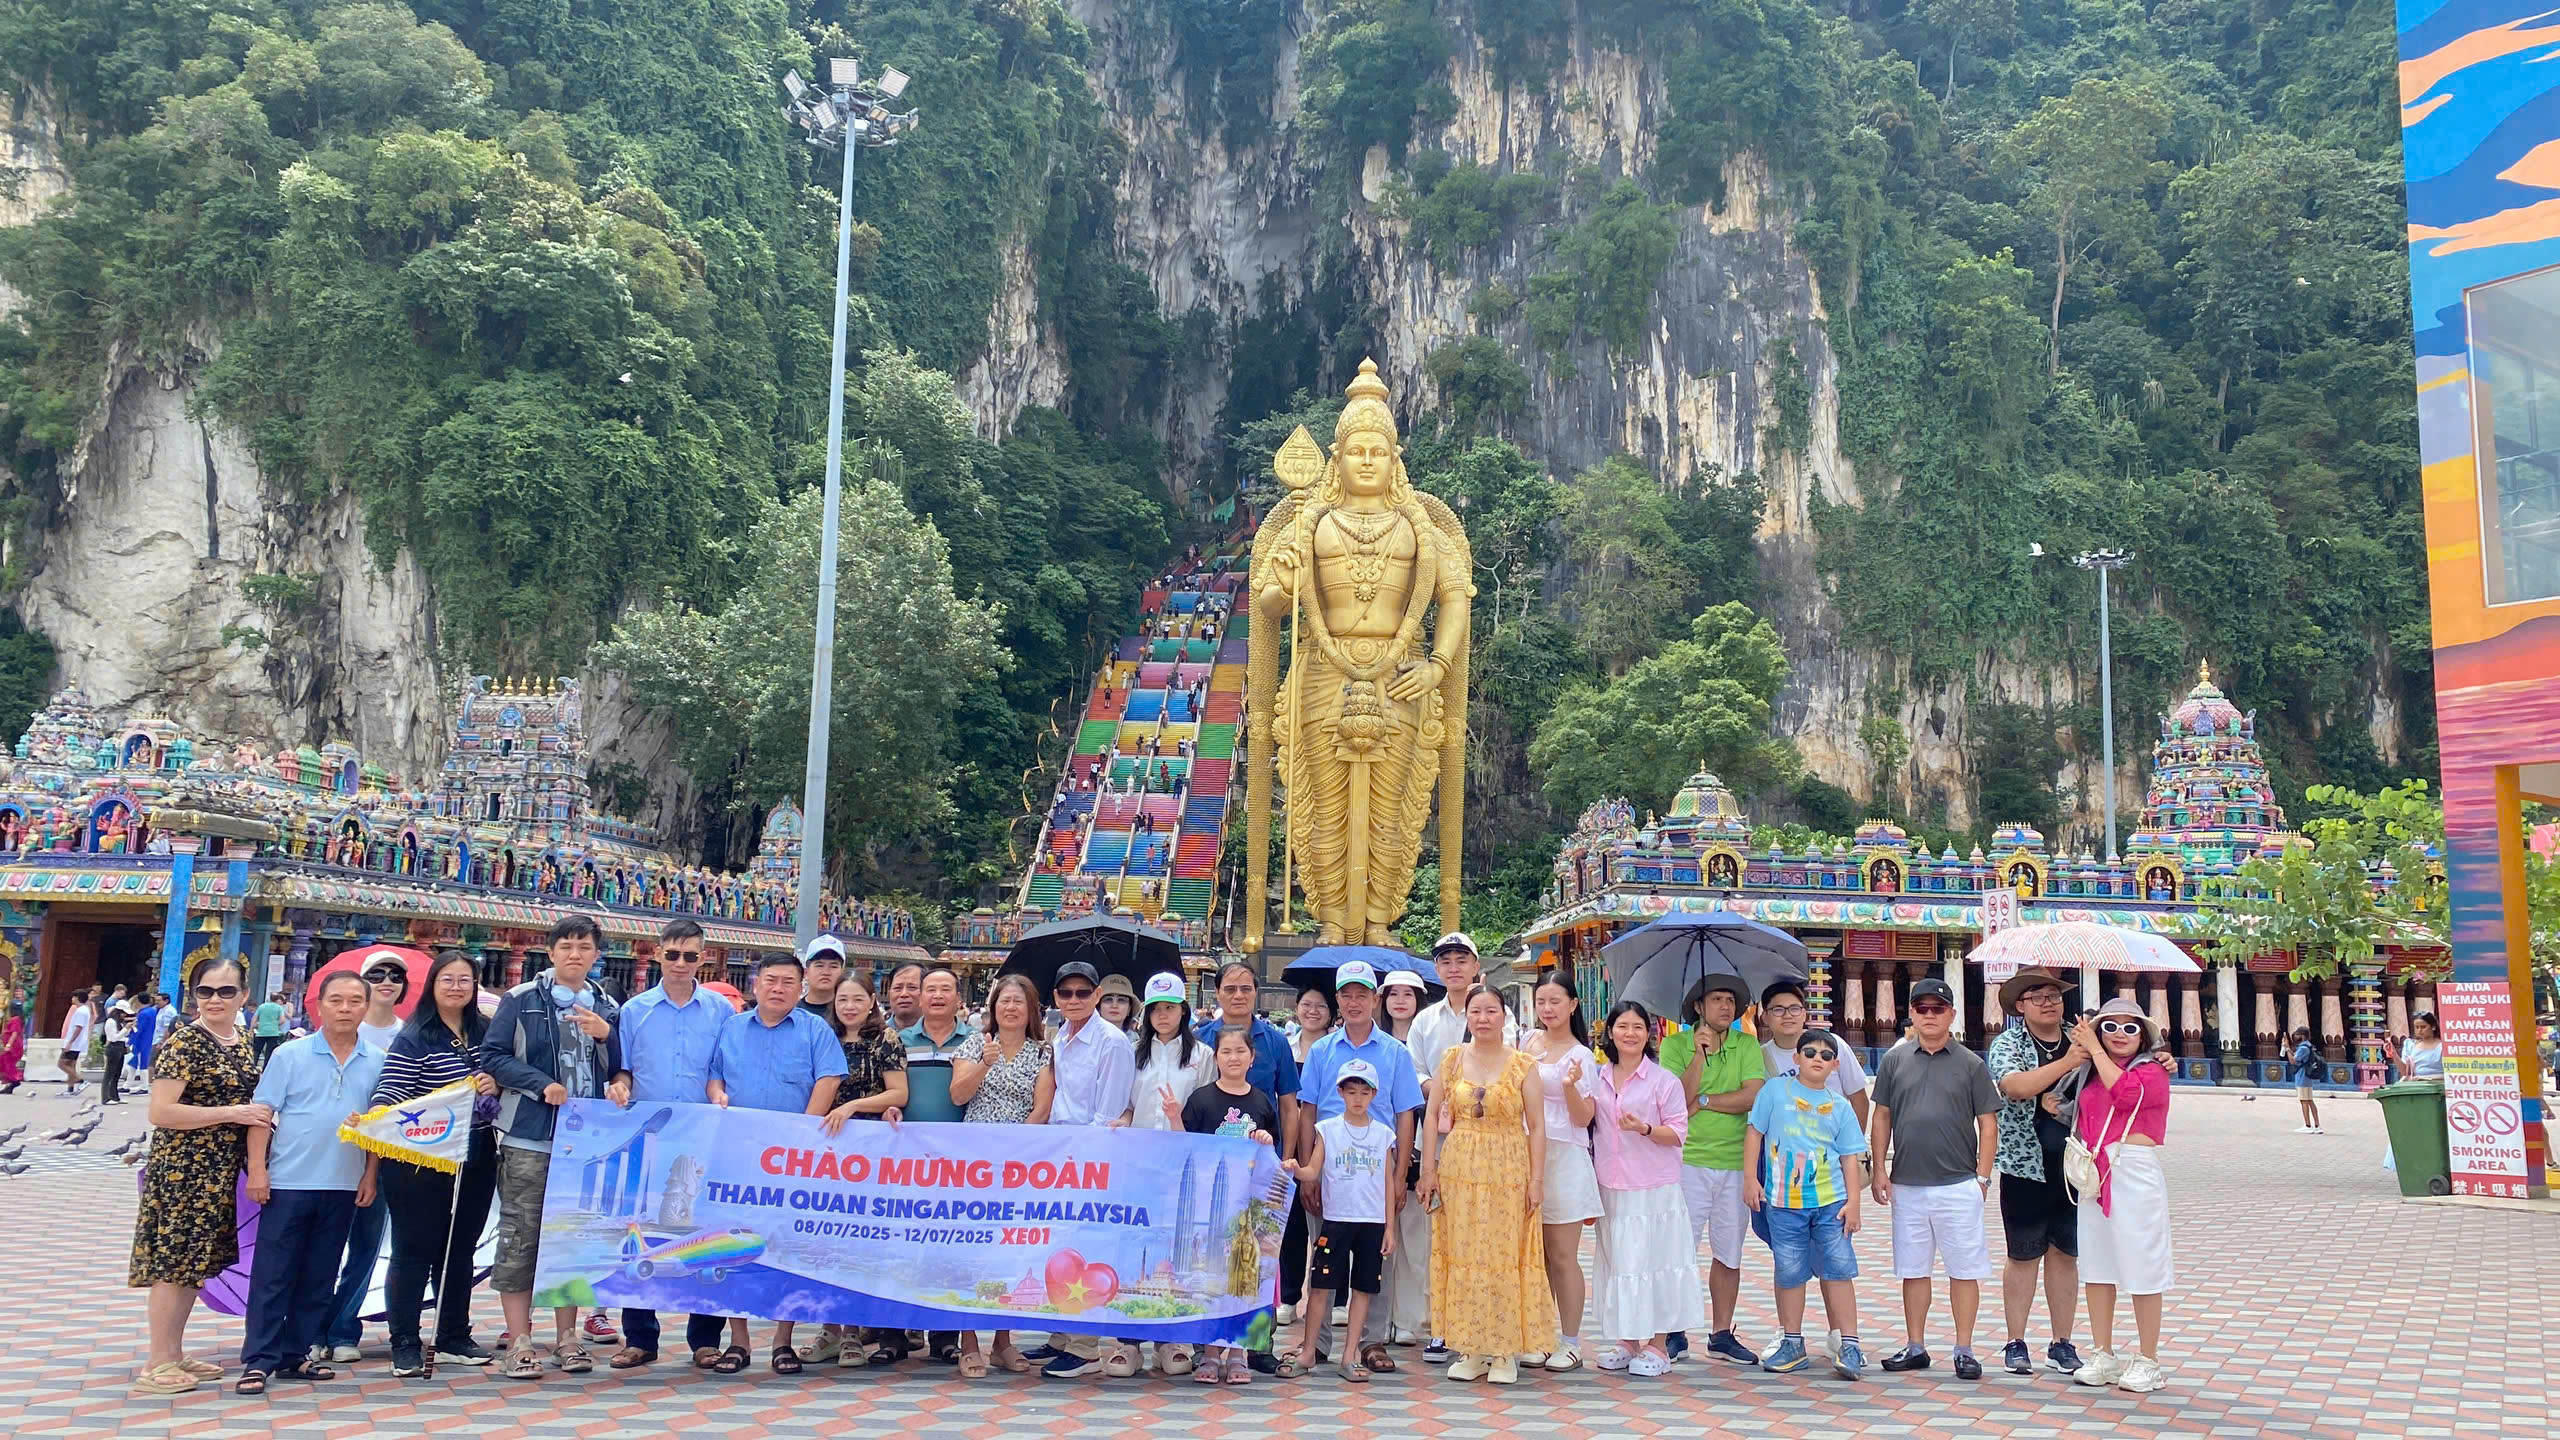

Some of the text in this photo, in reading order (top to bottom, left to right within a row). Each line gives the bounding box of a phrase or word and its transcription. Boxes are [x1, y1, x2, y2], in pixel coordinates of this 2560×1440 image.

[1987, 962, 2013, 973] ENTRY
[2455, 983, 2491, 992] ANDA
[2441, 994, 2511, 1005] MEMASUKI
[2468, 1007, 2486, 1017] KE
[2445, 1020, 2510, 1030] KAWASAN
[2443, 1032, 2515, 1043] LARANGAN
[2447, 1045, 2513, 1056] MEROKOK
[2449, 1075, 2513, 1086] YOU ARE
[2445, 1089, 2519, 1101] ENTERING
[405, 1126, 446, 1137] GROUP
[2475, 1134, 2496, 1145] NO
[2452, 1146, 2522, 1159] SMOKING
[760, 1146, 1111, 1190] CHÀO MỪNG ĐOÀN
[2468, 1160, 2508, 1171] AREA
[707, 1181, 1150, 1227] THAM QUAN SINGAPORE-MALAYSIA
[793, 1219, 890, 1241] 08/07/2025
[904, 1228, 993, 1245] 12/07/2025
[1000, 1227, 1051, 1245] XE01
